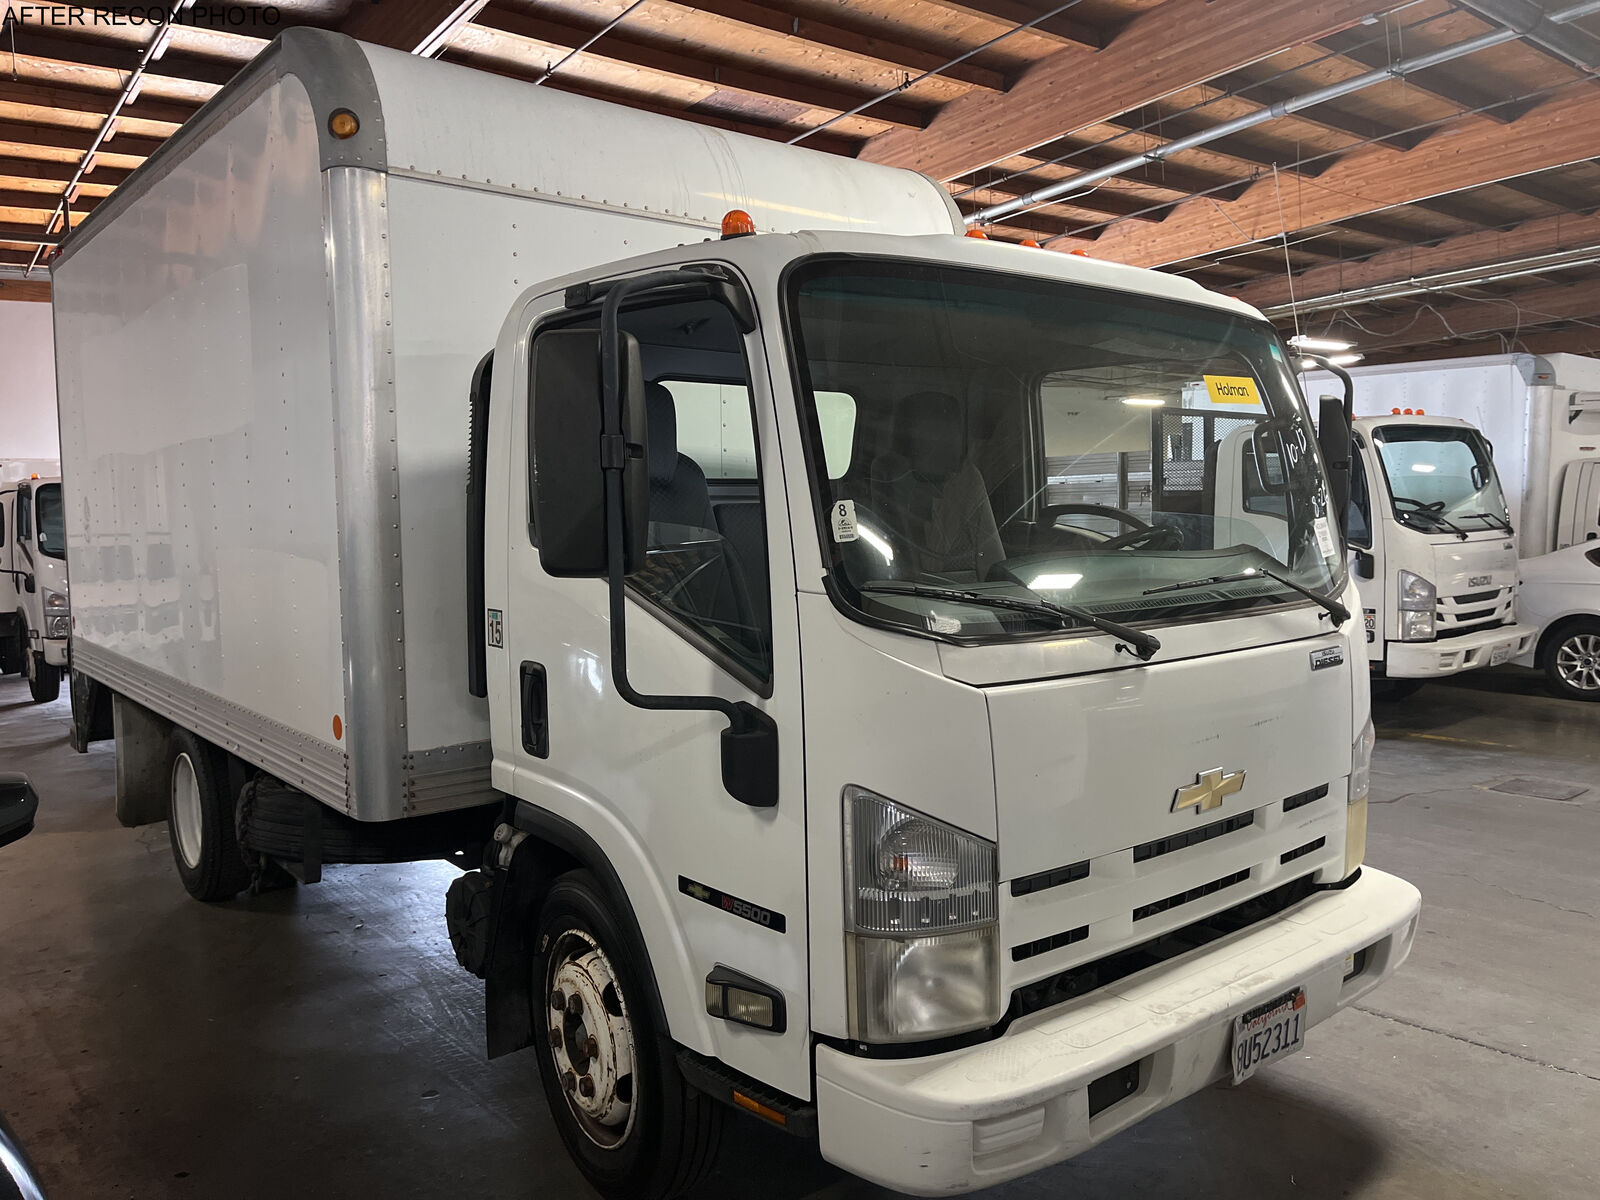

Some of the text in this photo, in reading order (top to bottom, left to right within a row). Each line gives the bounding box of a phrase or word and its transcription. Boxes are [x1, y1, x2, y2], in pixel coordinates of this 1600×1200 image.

[1215, 382, 1249, 397] Holman
[838, 503, 847, 517] 8
[490, 620, 501, 645] 15
[721, 895, 771, 926] W5500
[1237, 1013, 1300, 1074] 8U52311
